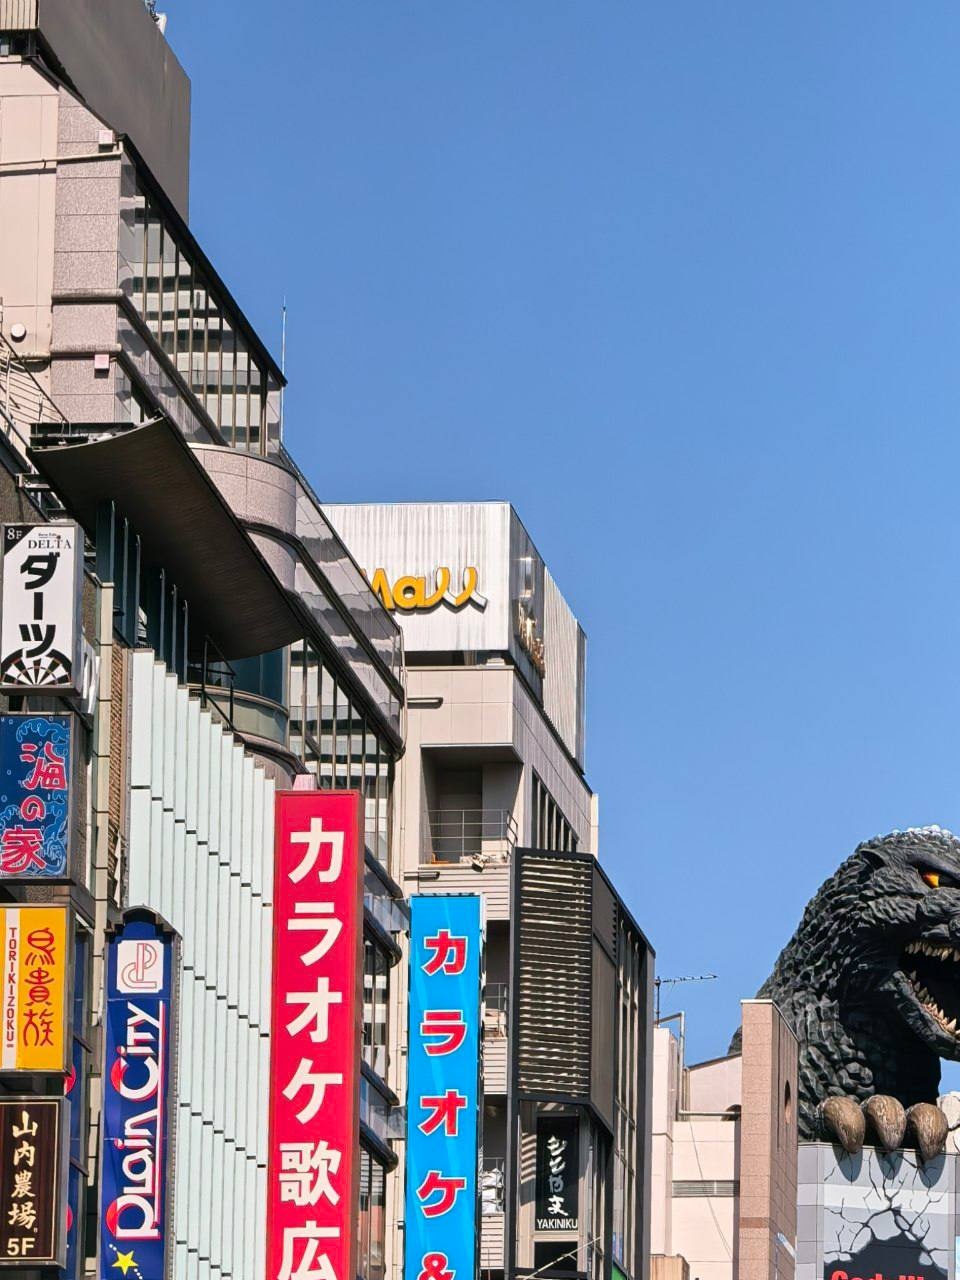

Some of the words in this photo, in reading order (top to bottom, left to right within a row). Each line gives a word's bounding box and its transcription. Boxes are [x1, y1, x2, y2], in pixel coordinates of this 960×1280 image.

[7, 528, 23, 540] 8F
[28, 539, 72, 549] DELTA
[19, 551, 60, 659] ダーツ
[1, 741, 68, 875] 海の家
[6, 927, 18, 1041] TORIKIZOKU
[23, 927, 56, 1047] 鳥貴族
[110, 1000, 164, 1102] City
[8, 1109, 38, 1231] 山内農場
[7, 1238, 36, 1256] 5F
[537, 1218, 578, 1230] YAKINIKU
